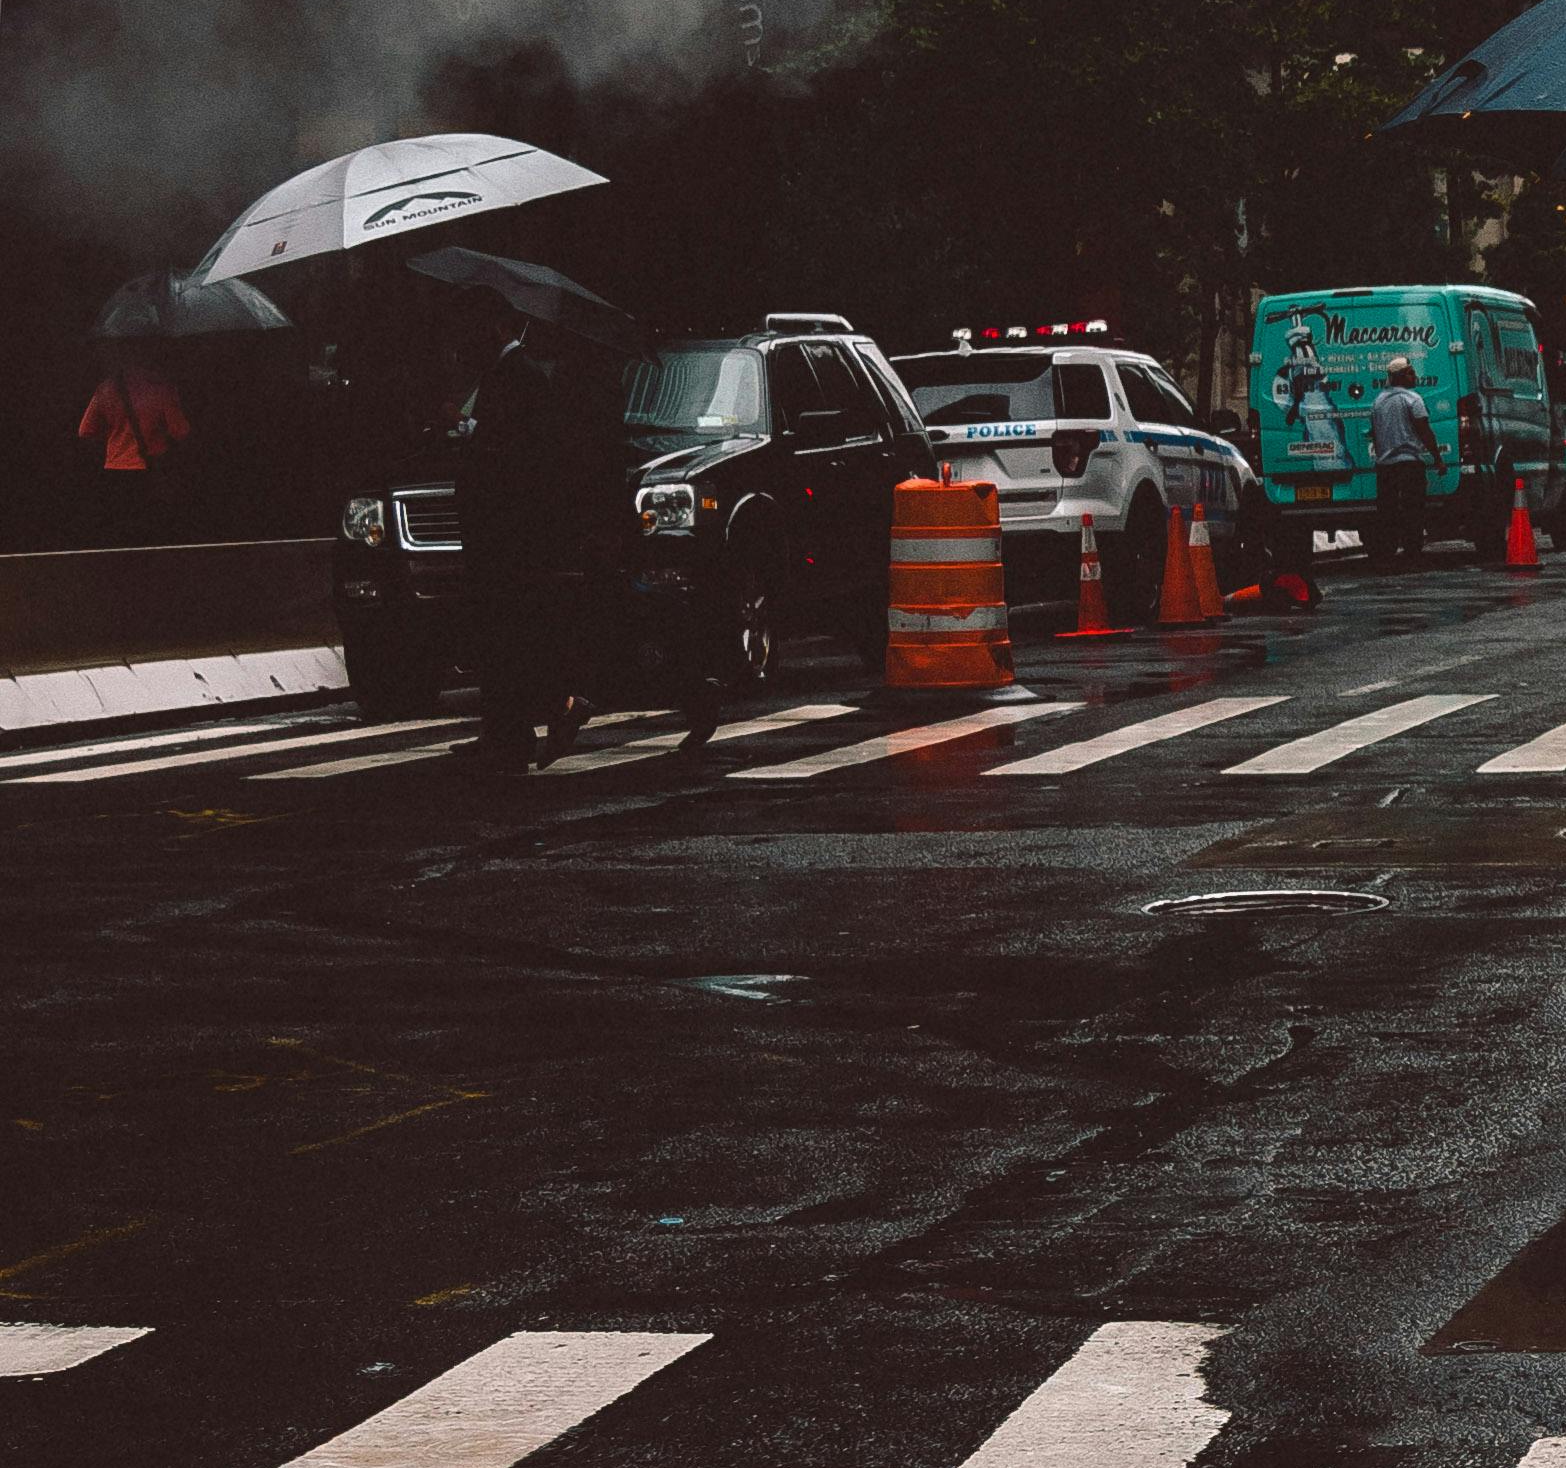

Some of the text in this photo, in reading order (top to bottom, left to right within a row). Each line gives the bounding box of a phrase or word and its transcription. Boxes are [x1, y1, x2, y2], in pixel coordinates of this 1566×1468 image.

[363, 195, 483, 231] SUN MOUNTAIN
[1325, 312, 1441, 349] Maccarone
[966, 423, 1037, 439] POLICE
